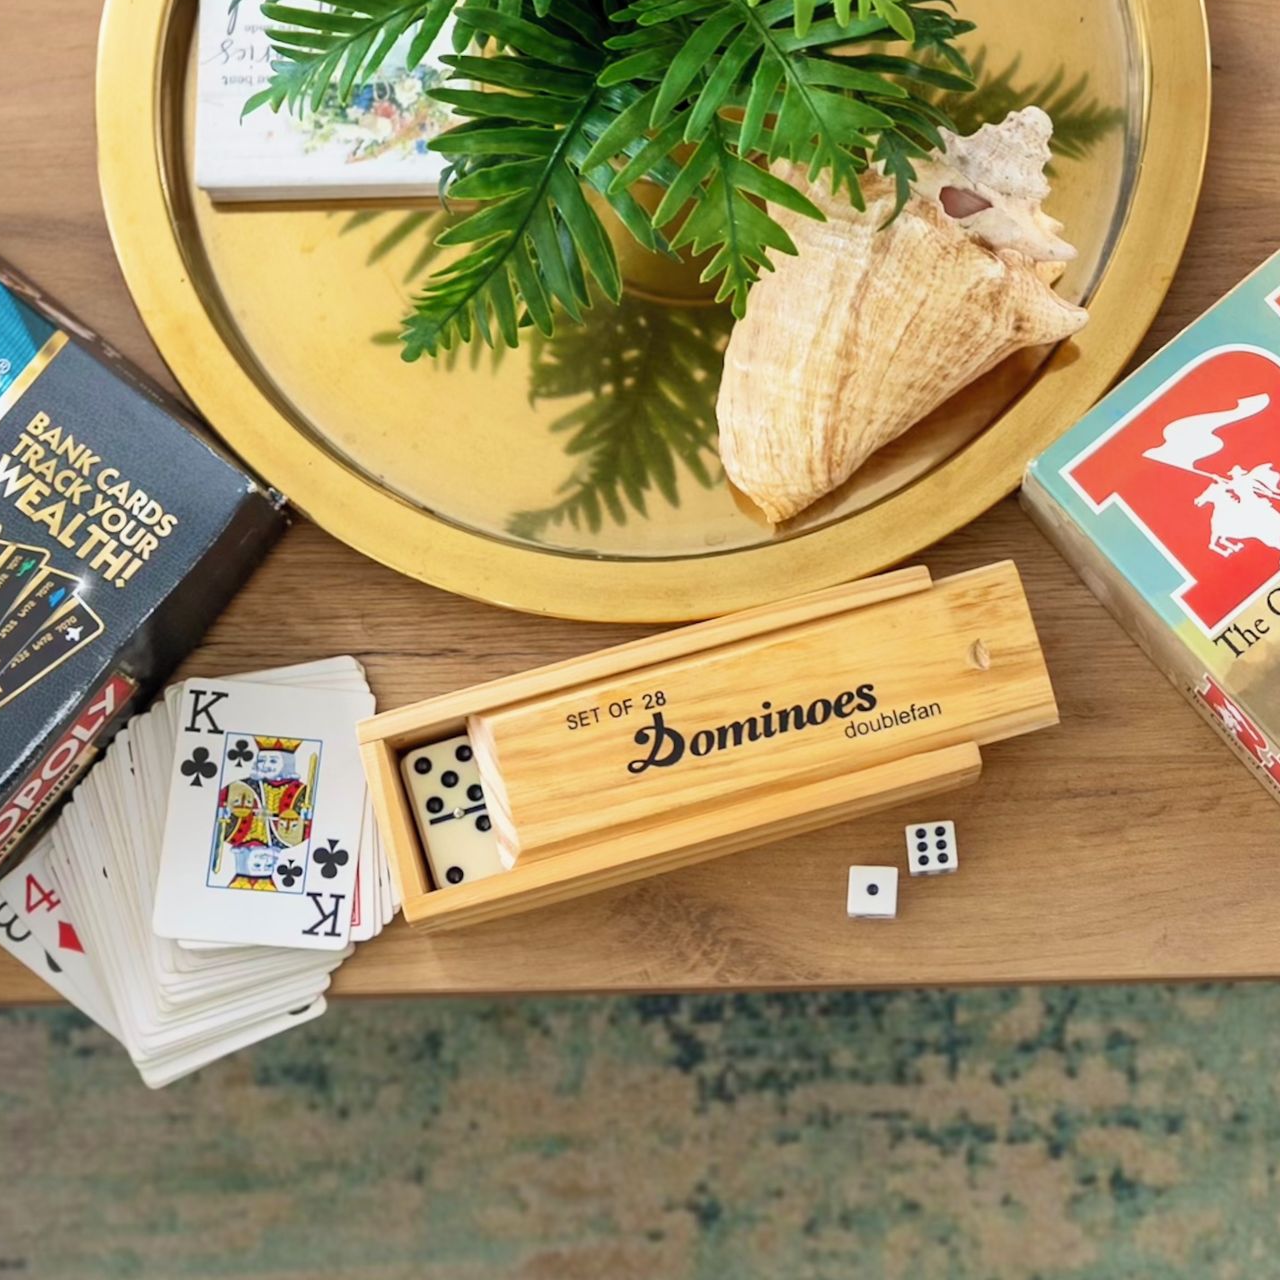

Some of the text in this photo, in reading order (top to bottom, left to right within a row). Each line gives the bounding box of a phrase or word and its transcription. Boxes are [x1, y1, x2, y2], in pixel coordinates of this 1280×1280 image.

[10, 432, 159, 560] TRACK YOUR
[26, 410, 178, 538] BANK CARDS
[1213, 613, 1270, 659] The
[184, 688, 230, 736] K
[566, 690, 667, 731] SET OF 28
[627, 682, 878, 774] Dominoes
[843, 700, 943, 740] doublefan
[24, 872, 62, 914] 4
[300, 891, 348, 938] K
